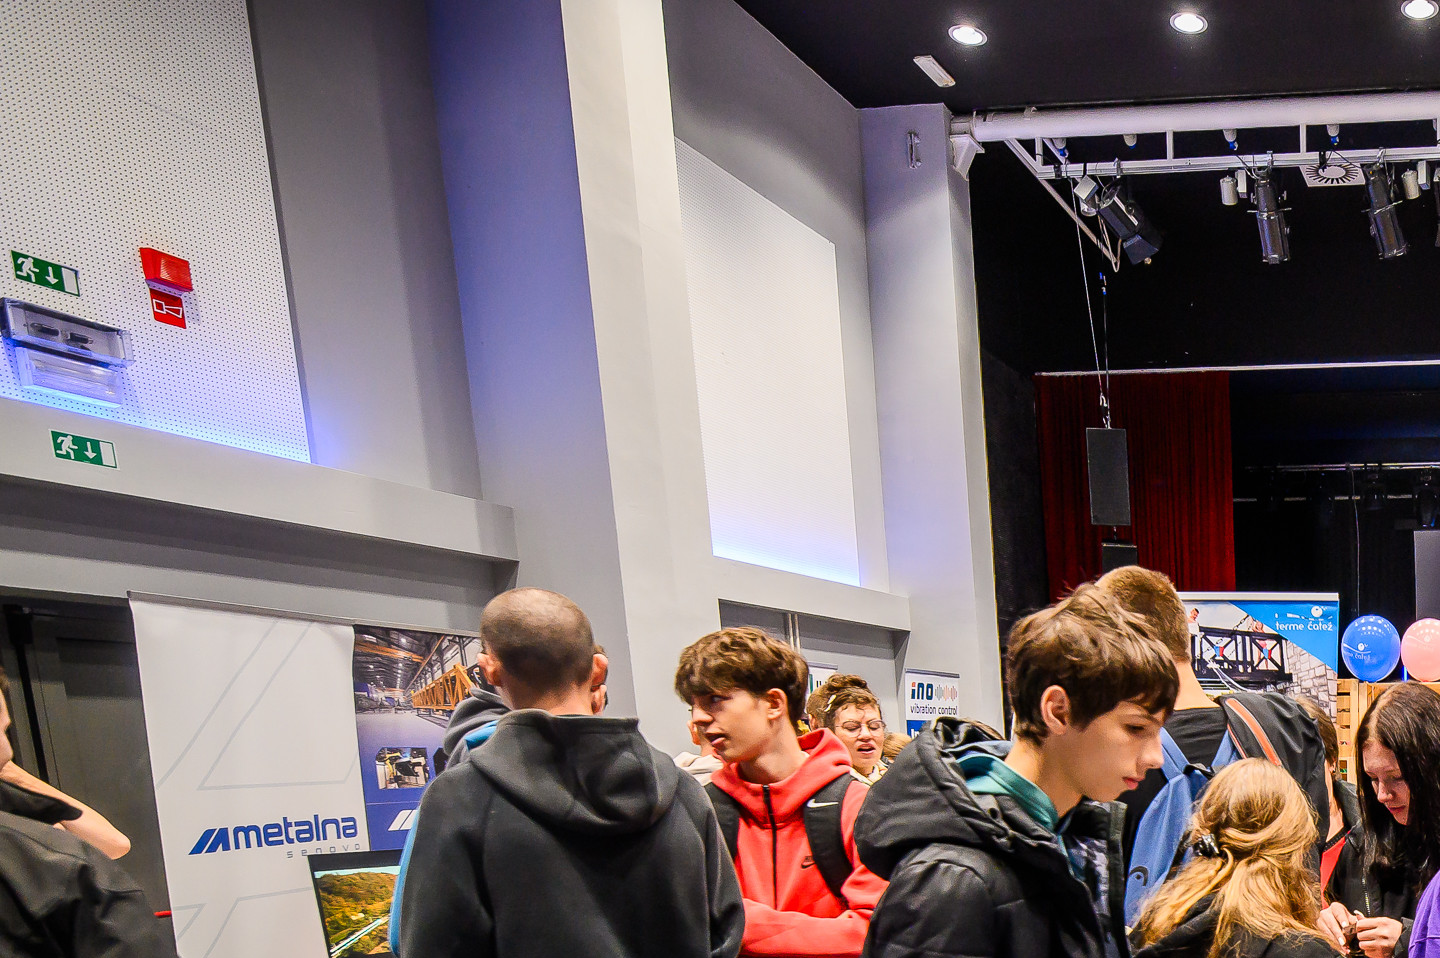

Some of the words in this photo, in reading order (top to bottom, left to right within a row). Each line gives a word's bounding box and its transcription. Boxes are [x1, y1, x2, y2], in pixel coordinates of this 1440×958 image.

[1275, 620, 1305, 631] terme
[911, 682, 934, 700] ino
[910, 703, 937, 715] vibration
[938, 705, 958, 716] control
[232, 814, 358, 850] metalna
